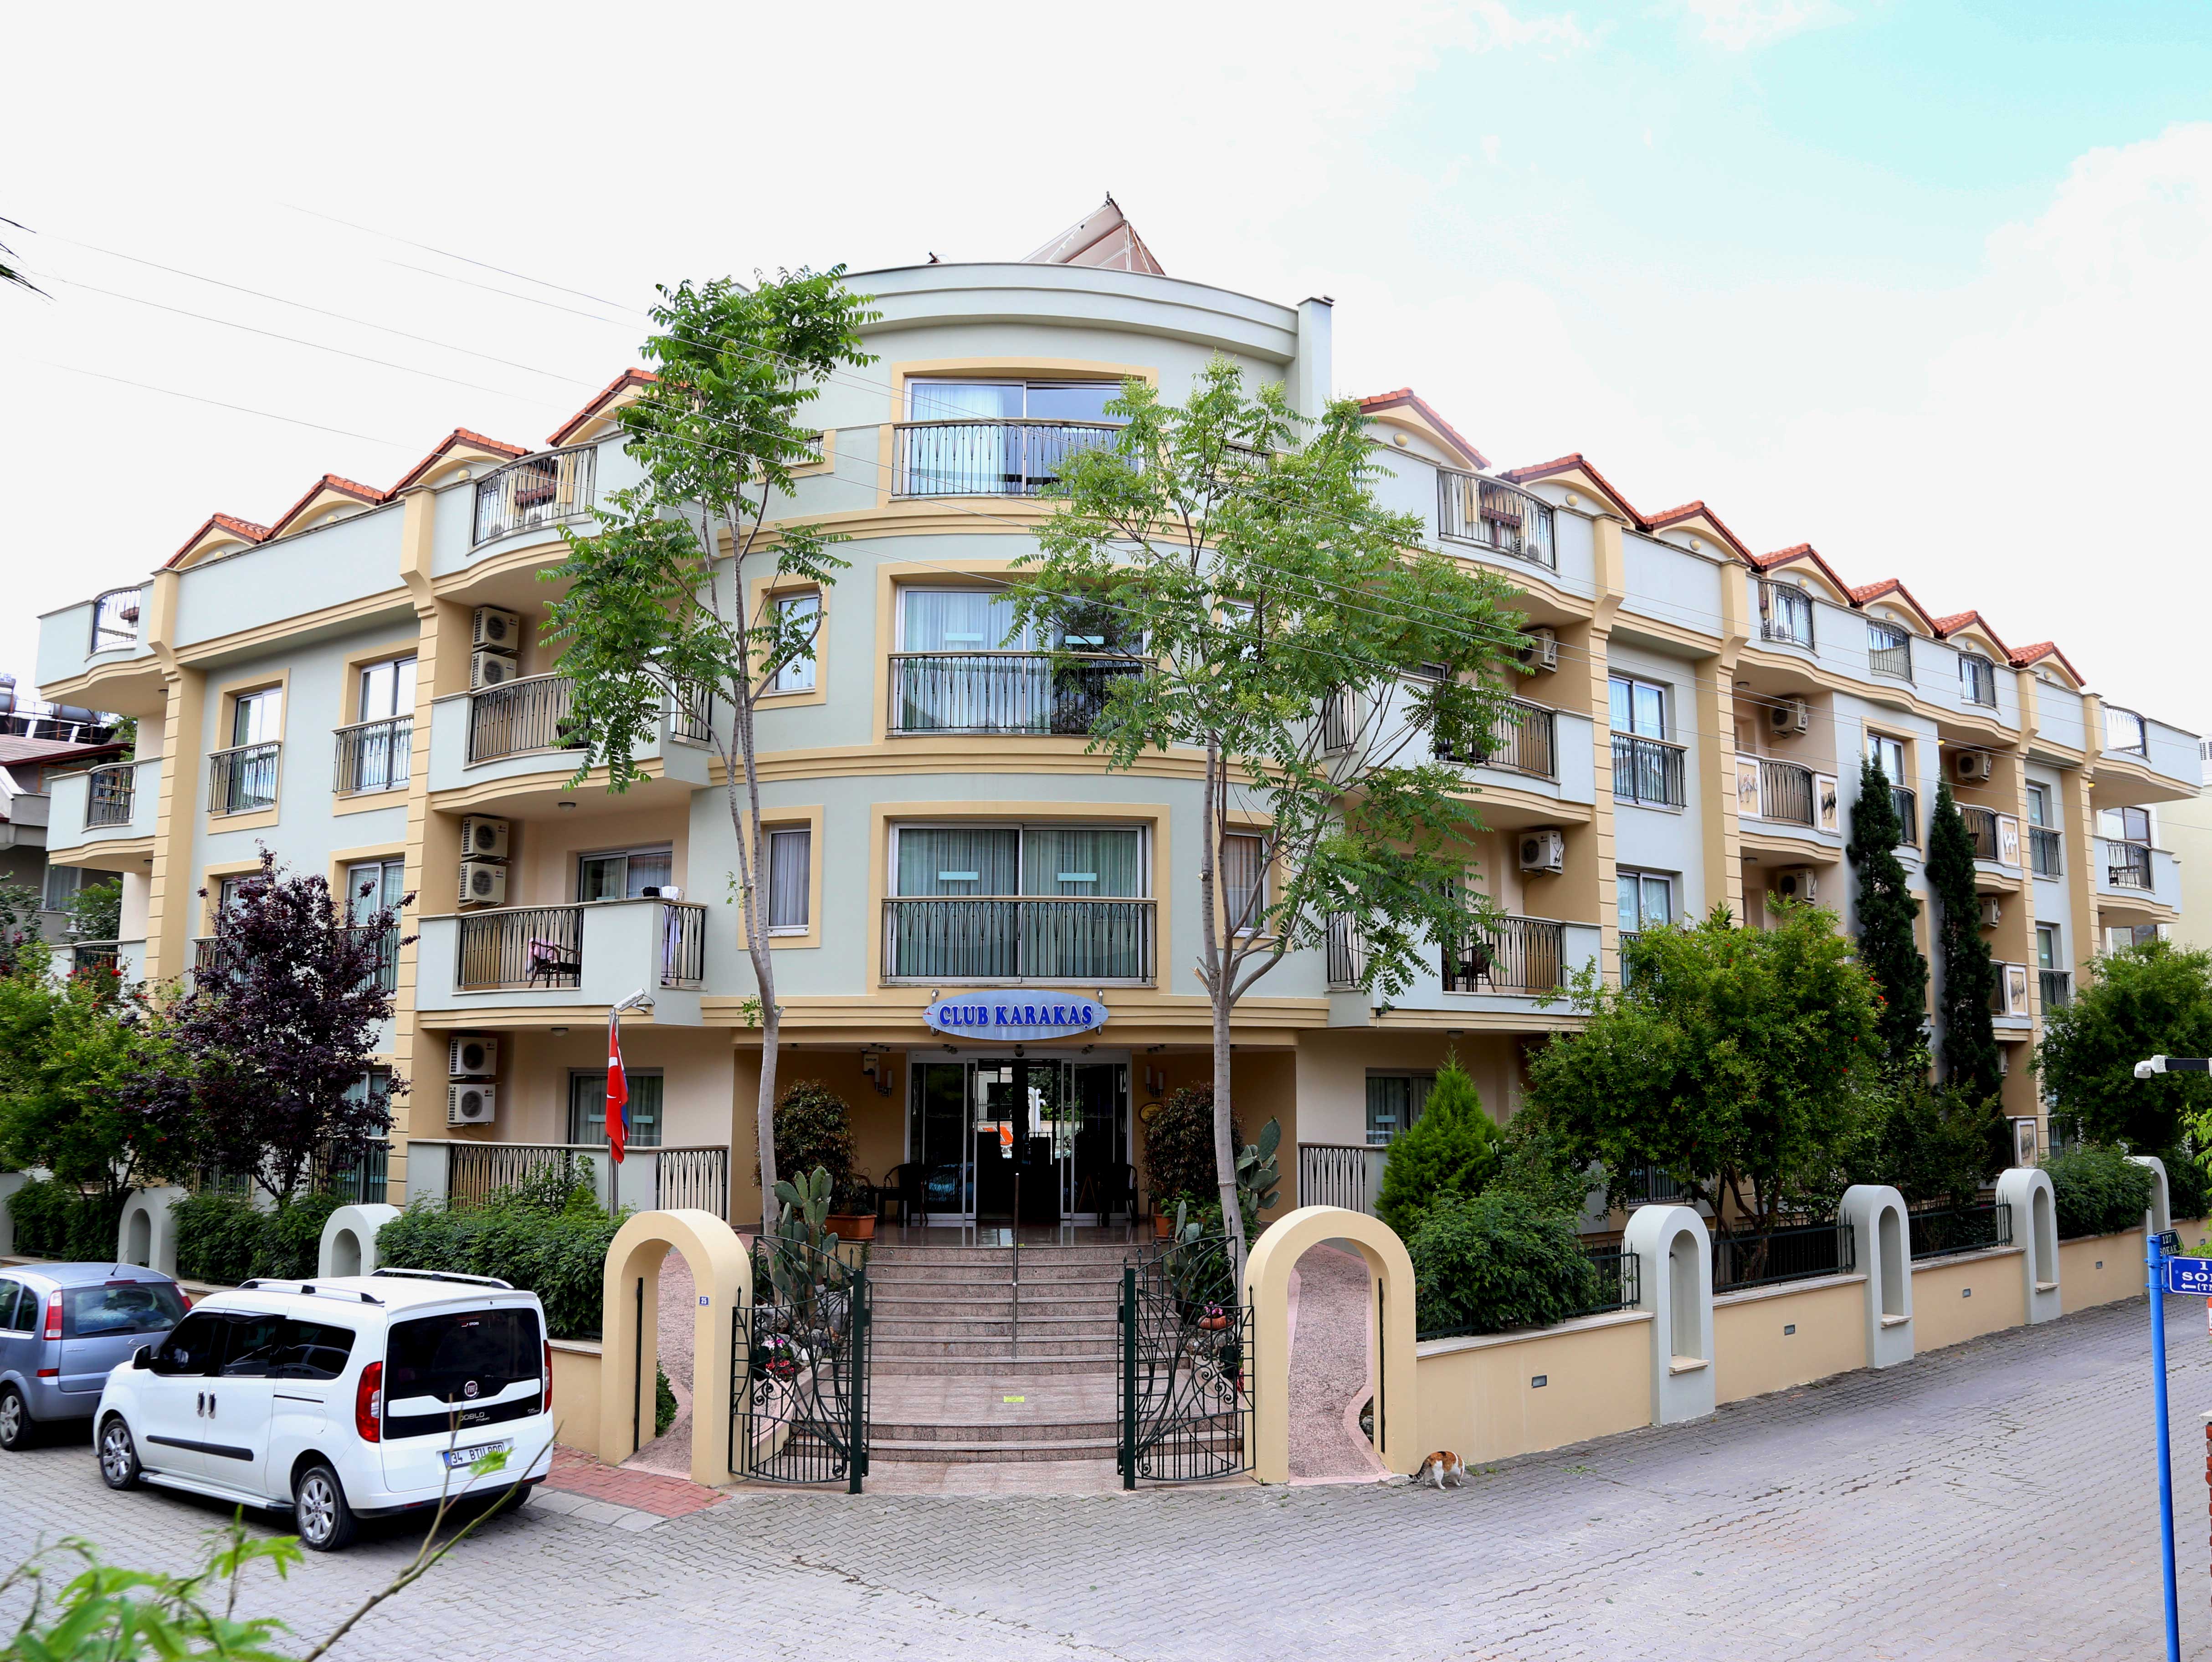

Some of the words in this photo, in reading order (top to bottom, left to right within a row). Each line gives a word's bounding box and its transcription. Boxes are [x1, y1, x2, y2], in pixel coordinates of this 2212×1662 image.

[939, 1005, 989, 1026] CLUB
[2162, 1234, 2172, 1244] 127
[2160, 1245, 2177, 1256] SOKAK
[459, 1412, 485, 1421] DOBLO
[452, 1452, 463, 1463] 34
[469, 1447, 486, 1460] BTU
